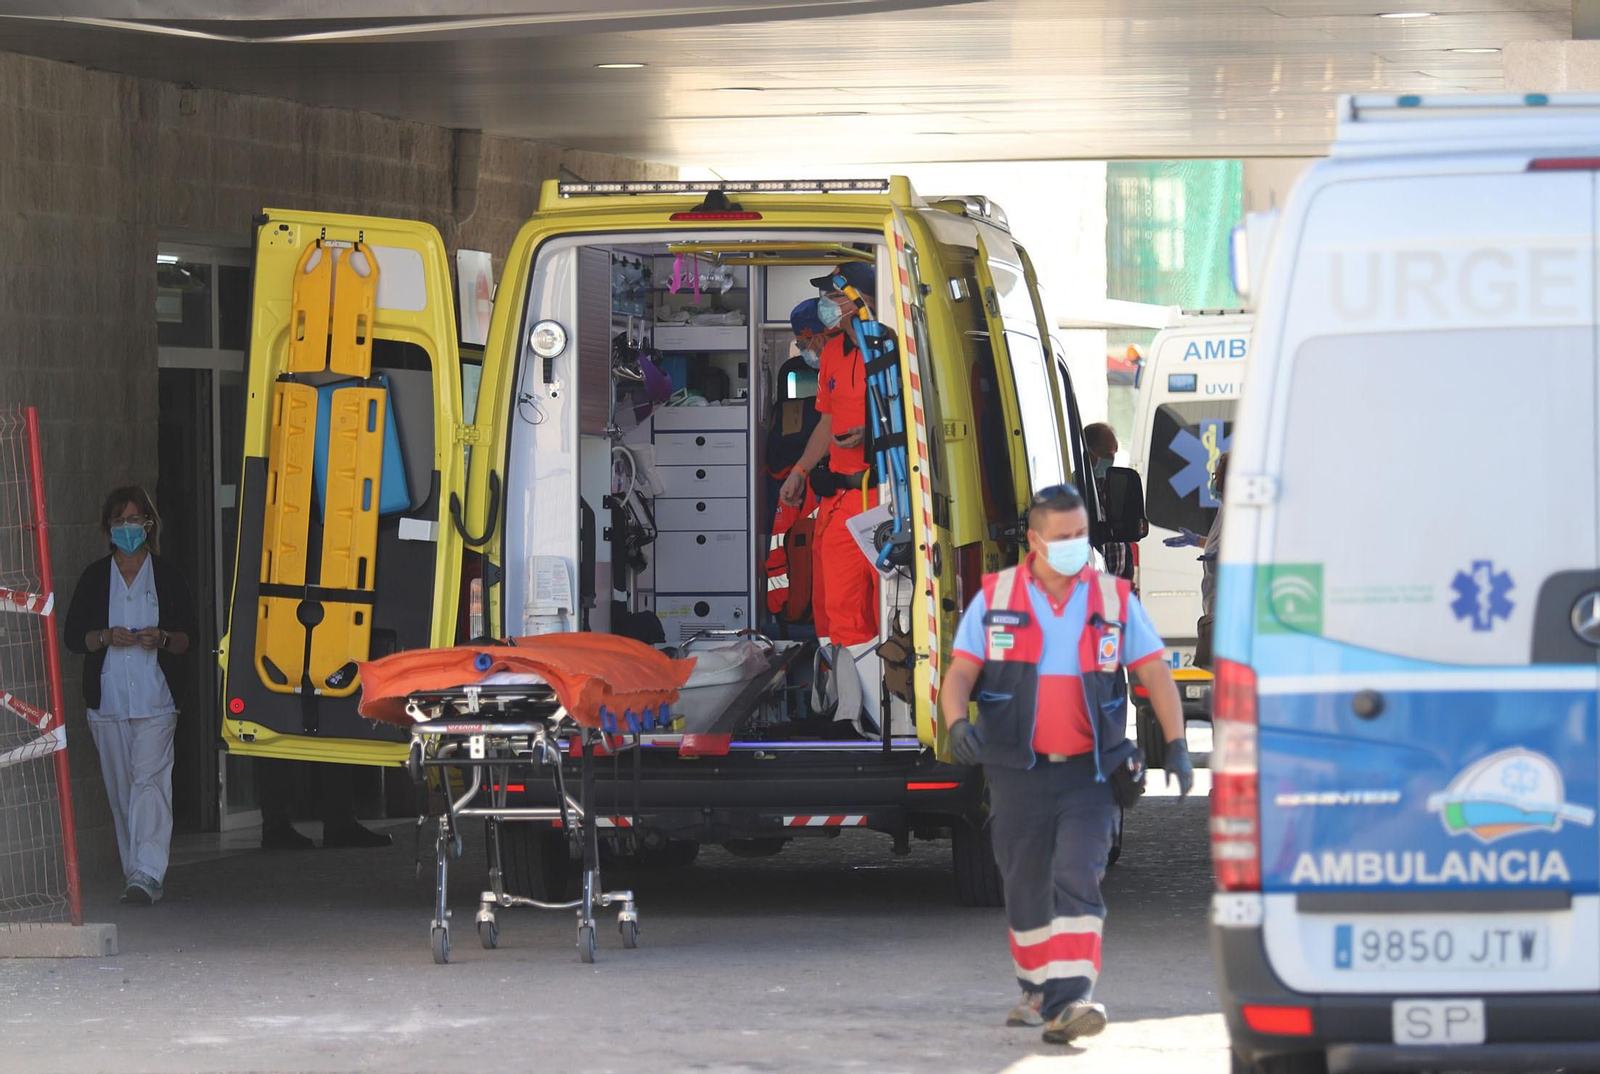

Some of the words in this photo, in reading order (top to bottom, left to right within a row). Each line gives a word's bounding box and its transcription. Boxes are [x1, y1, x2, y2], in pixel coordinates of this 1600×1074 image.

[1205, 383, 1233, 395] UVI
[1290, 850, 1571, 884] AMBULANCIA
[1361, 929, 1454, 962] 9850
[1470, 929, 1537, 962] JTW
[1406, 1006, 1471, 1039] SP
